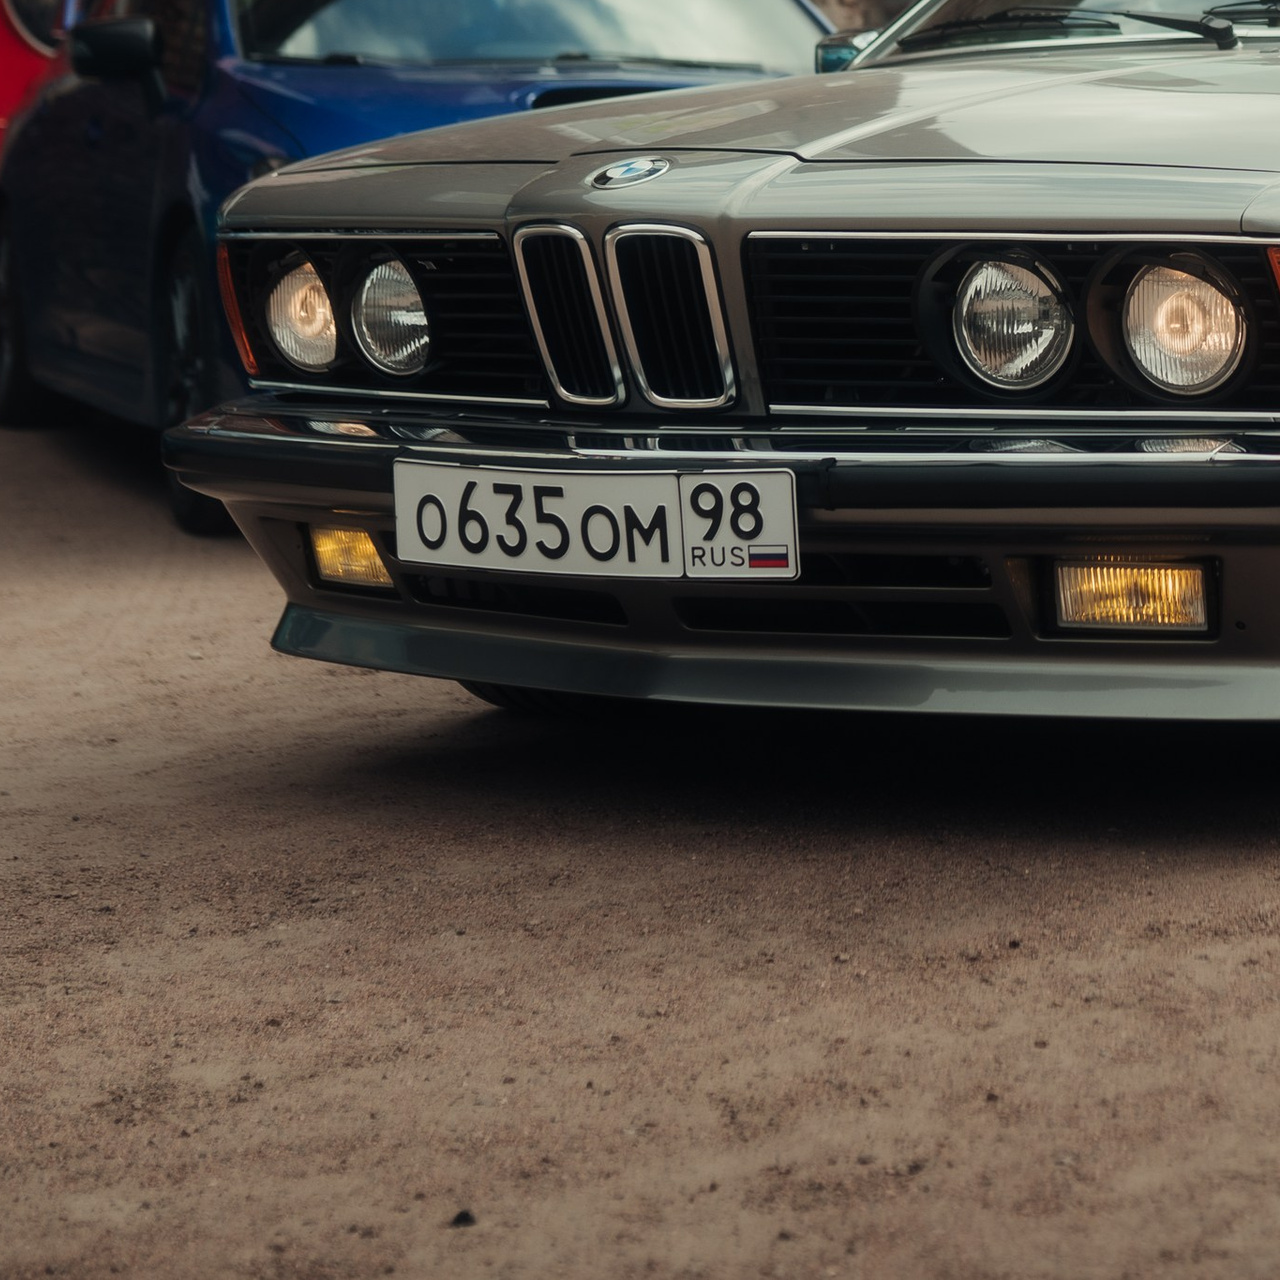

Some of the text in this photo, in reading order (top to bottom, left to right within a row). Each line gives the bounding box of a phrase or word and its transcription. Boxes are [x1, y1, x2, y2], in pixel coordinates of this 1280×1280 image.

[416, 481, 764, 563] O635OM 98
[691, 546, 745, 567] RUS
